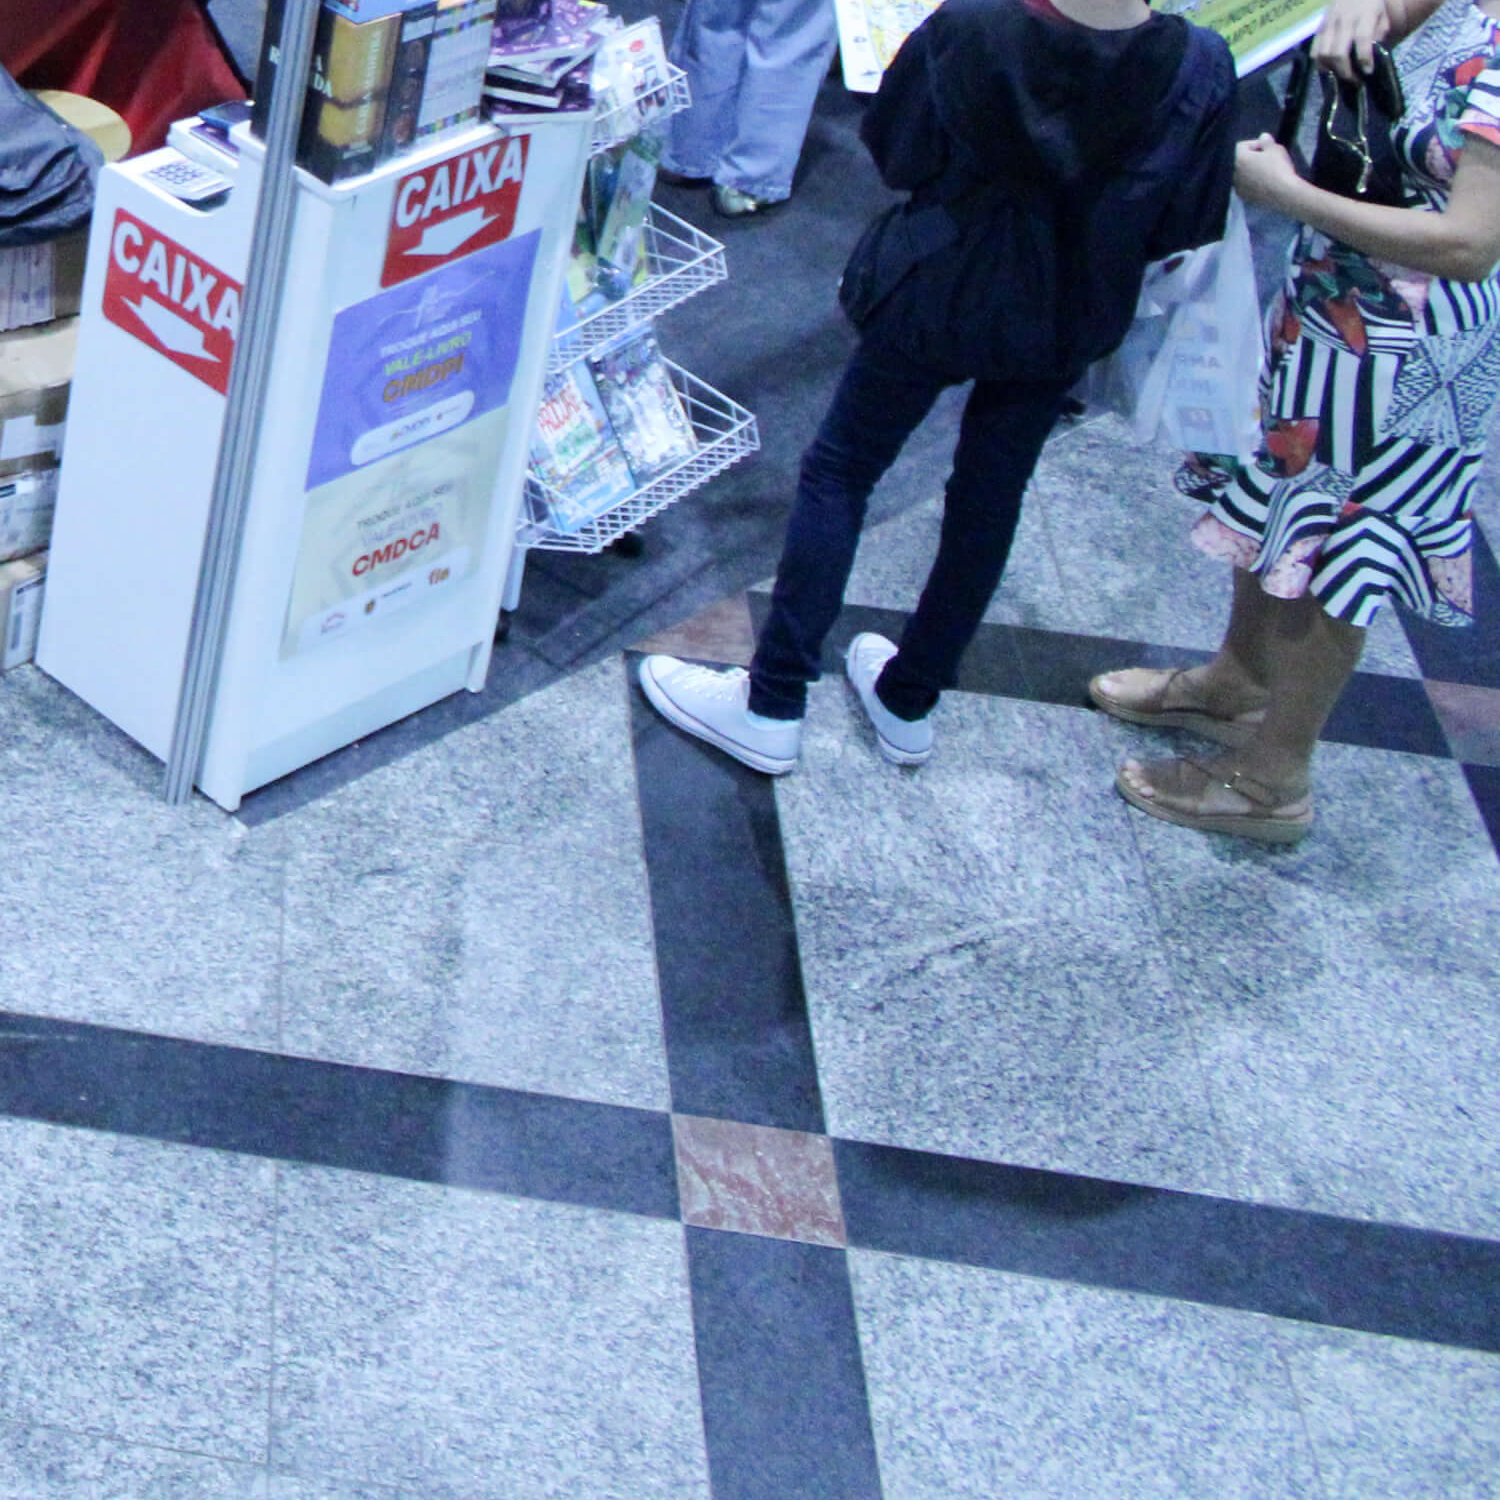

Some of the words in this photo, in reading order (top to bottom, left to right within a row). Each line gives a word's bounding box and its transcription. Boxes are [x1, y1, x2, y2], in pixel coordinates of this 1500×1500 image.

[395, 135, 525, 231] CAIXA
[112, 220, 242, 333] CAIXA
[384, 330, 472, 377] VALE-LIVRO
[351, 522, 441, 577] CMDCA
